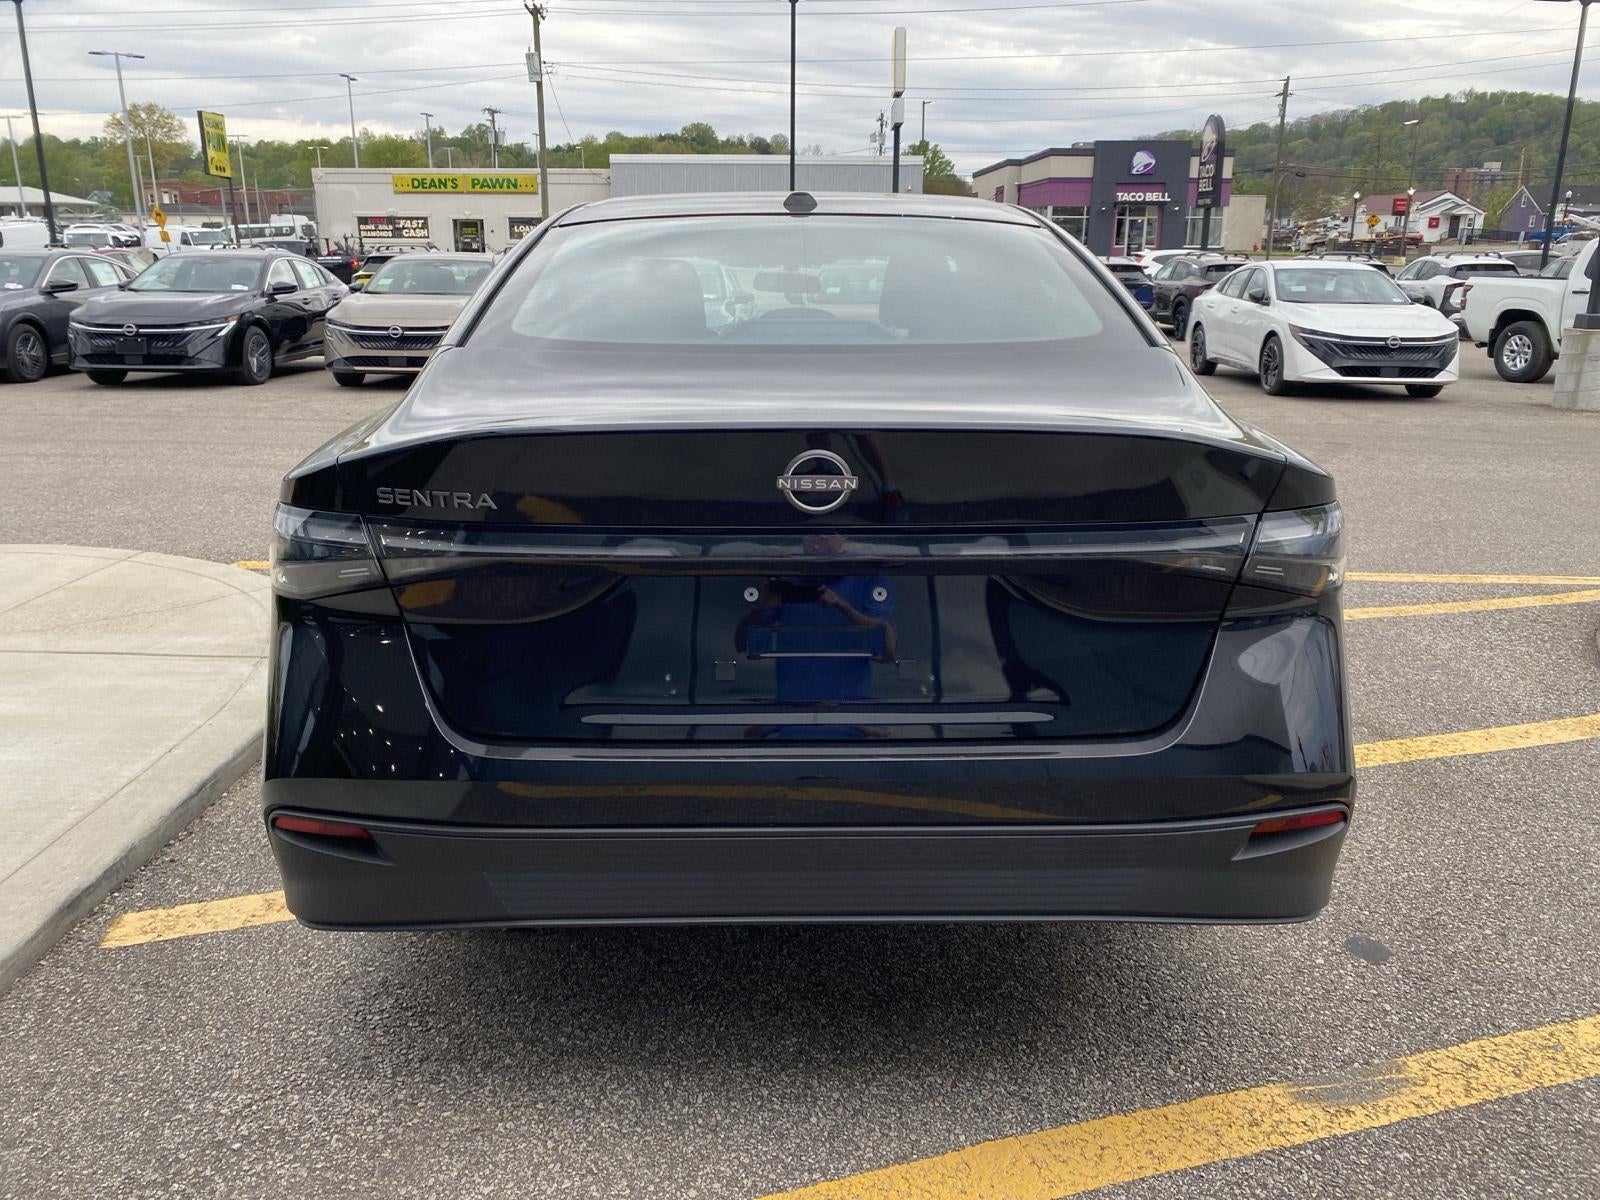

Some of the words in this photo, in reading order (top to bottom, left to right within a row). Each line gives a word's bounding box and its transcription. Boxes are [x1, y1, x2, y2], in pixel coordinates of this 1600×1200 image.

[411, 178, 458, 189] DEAN'S
[471, 178, 518, 189] PAWN
[1116, 192, 1144, 201] TACO
[1145, 192, 1171, 201] BELL
[400, 219, 425, 228] FAST
[402, 228, 428, 238] CASH
[778, 478, 857, 489] NISSAN
[376, 486, 499, 510] SENTRA
